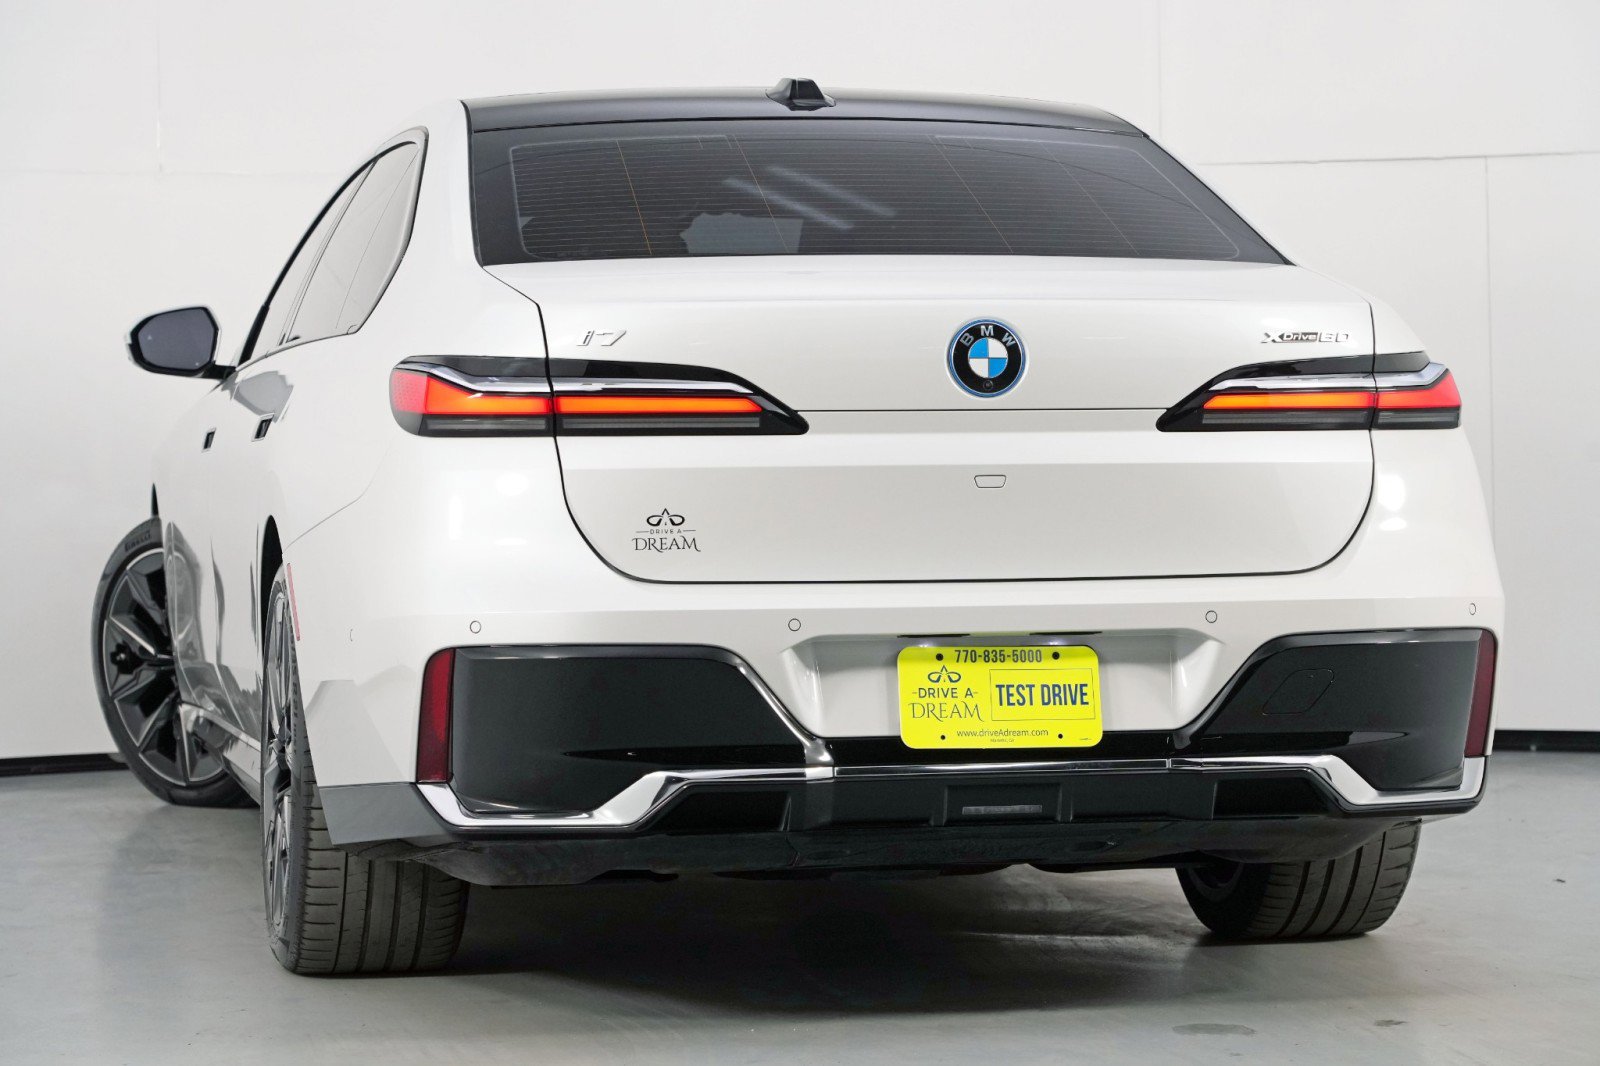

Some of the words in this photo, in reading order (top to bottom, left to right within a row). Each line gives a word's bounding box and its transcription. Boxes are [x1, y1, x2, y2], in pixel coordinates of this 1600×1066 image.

[576, 330, 627, 347] i7
[960, 324, 1016, 347] BMW
[631, 535, 702, 553] DREAM
[954, 649, 1042, 663] 770-835-5000
[918, 687, 959, 699] DRIVE
[964, 687, 974, 699] A
[995, 683, 1036, 707] TEST
[1041, 683, 1089, 706] DRIVE
[908, 700, 985, 722] DREAM
[956, 728, 1049, 738] www.driveAdream.com
